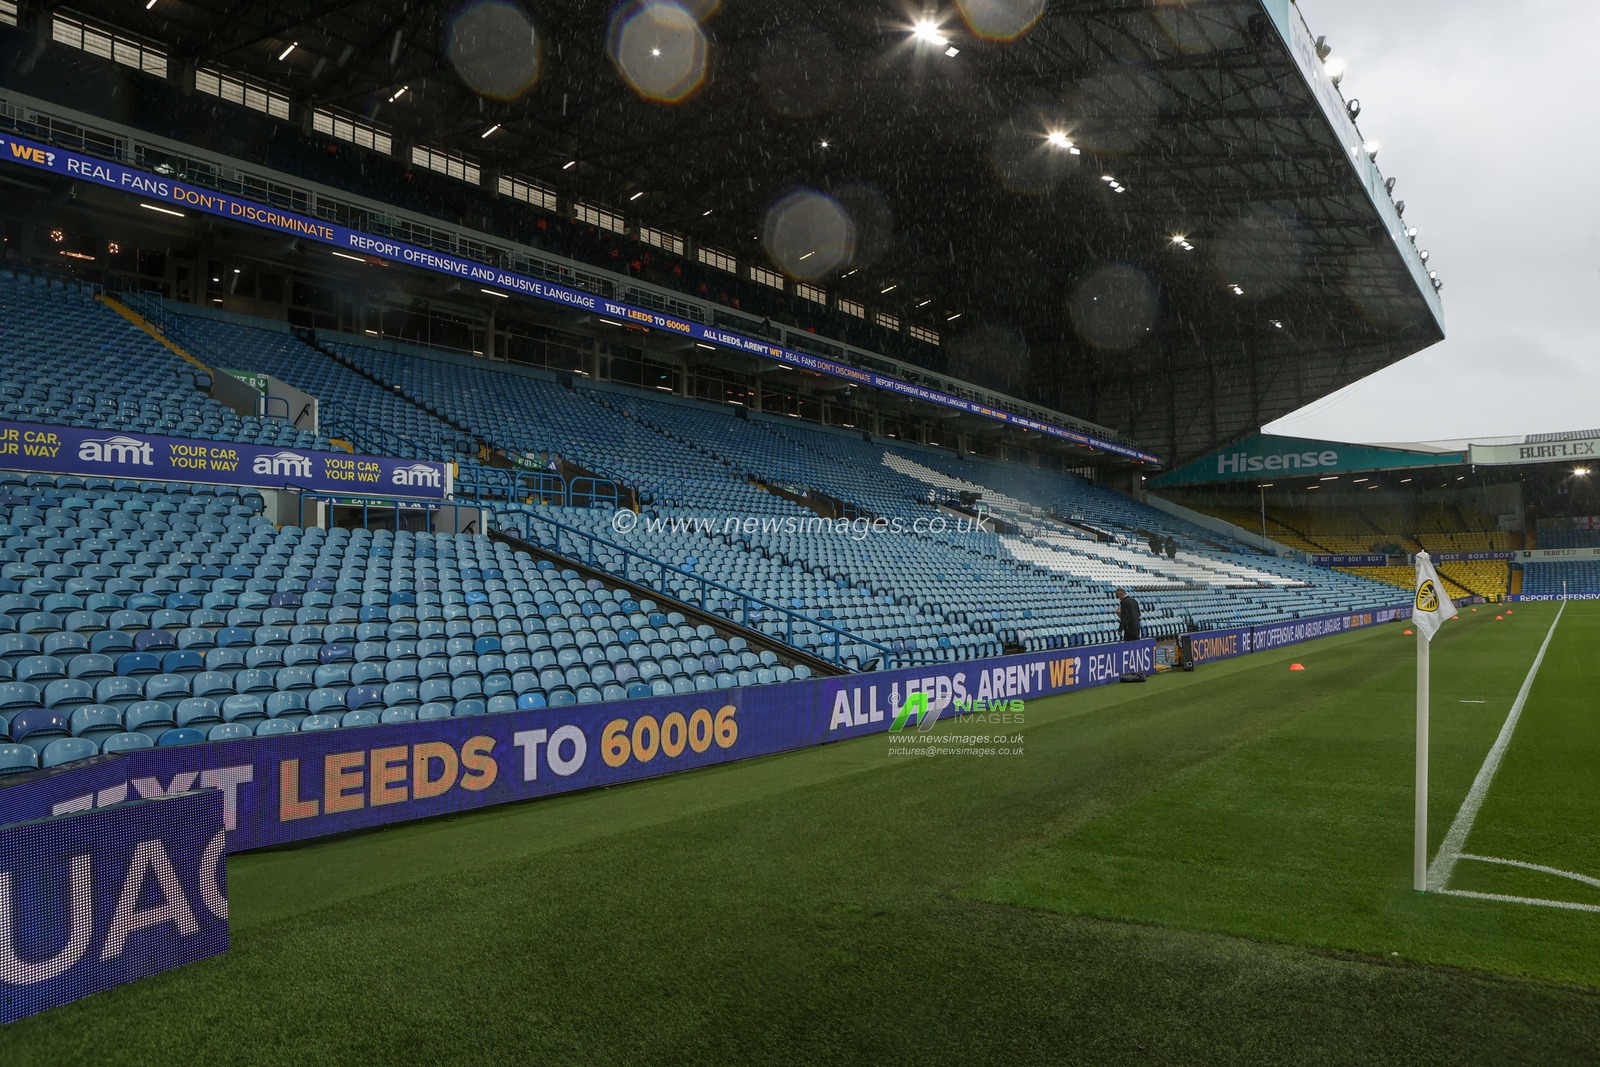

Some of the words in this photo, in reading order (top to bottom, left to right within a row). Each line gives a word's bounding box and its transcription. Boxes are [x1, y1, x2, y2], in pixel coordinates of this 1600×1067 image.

[10, 142, 56, 167] WE?
[67, 158, 116, 183] REAL
[121, 172, 169, 196] FANS
[173, 186, 226, 212] DON'T
[231, 202, 334, 240] DISCRIMINATE
[349, 234, 401, 257] REPORT
[403, 248, 468, 275] OFFENSIVE
[470, 267, 495, 281] AND
[497, 274, 542, 294] ABUSIVE
[544, 286, 595, 308] LANGUAGE
[604, 303, 626, 316] TEXT
[627, 309, 653, 323] LEEDS
[654, 316, 665, 326] TO
[666, 319, 690, 333] 60006
[703, 329, 717, 340] ALL
[718, 333, 742, 348] LEEDS,
[744, 340, 769, 354] AREN'T
[769, 348, 782, 357] WE?
[785, 352, 800, 363] REAL
[801, 356, 816, 368] FANS
[817, 361, 835, 372] DON'T
[835, 366, 871, 383] DISCRIMINATE
[875, 377, 894, 388] REPORT
[894, 383, 919, 395] OFFENSIVE
[919, 390, 929, 398] AND
[24, 431, 62, 447] CAR,
[23, 444, 60, 458] WAY
[78, 441, 154, 466] amt
[169, 444, 207, 457] YOUR
[210, 448, 240, 461] CAR,
[169, 457, 207, 469] YOUR
[210, 460, 238, 471] WAY
[252, 455, 312, 478] amt
[324, 458, 355, 470] YOUR
[357, 461, 381, 473] CAR,
[1217, 451, 1338, 474] Hisense
[324, 469, 355, 481] YOUR
[357, 472, 381, 483] WAY
[391, 467, 441, 488] amt
[1520, 594, 1554, 602] REPORT
[279, 735, 498, 823] LEEDS
[513, 724, 587, 782] TO
[600, 704, 738, 768] 60006
[829, 685, 884, 730] ALL
[891, 672, 972, 719] LEEDS,
[977, 661, 1046, 700] AREN'T
[1049, 656, 1081, 688] WE?
[1089, 653, 1119, 683] REAL
[1122, 647, 1150, 674] FANS
[1242, 631, 1266, 651] REPORT
[1267, 626, 1294, 646] OFFENSIVE
[1294, 624, 1305, 640] AND
[1305, 620, 1322, 638] ABUSIVE
